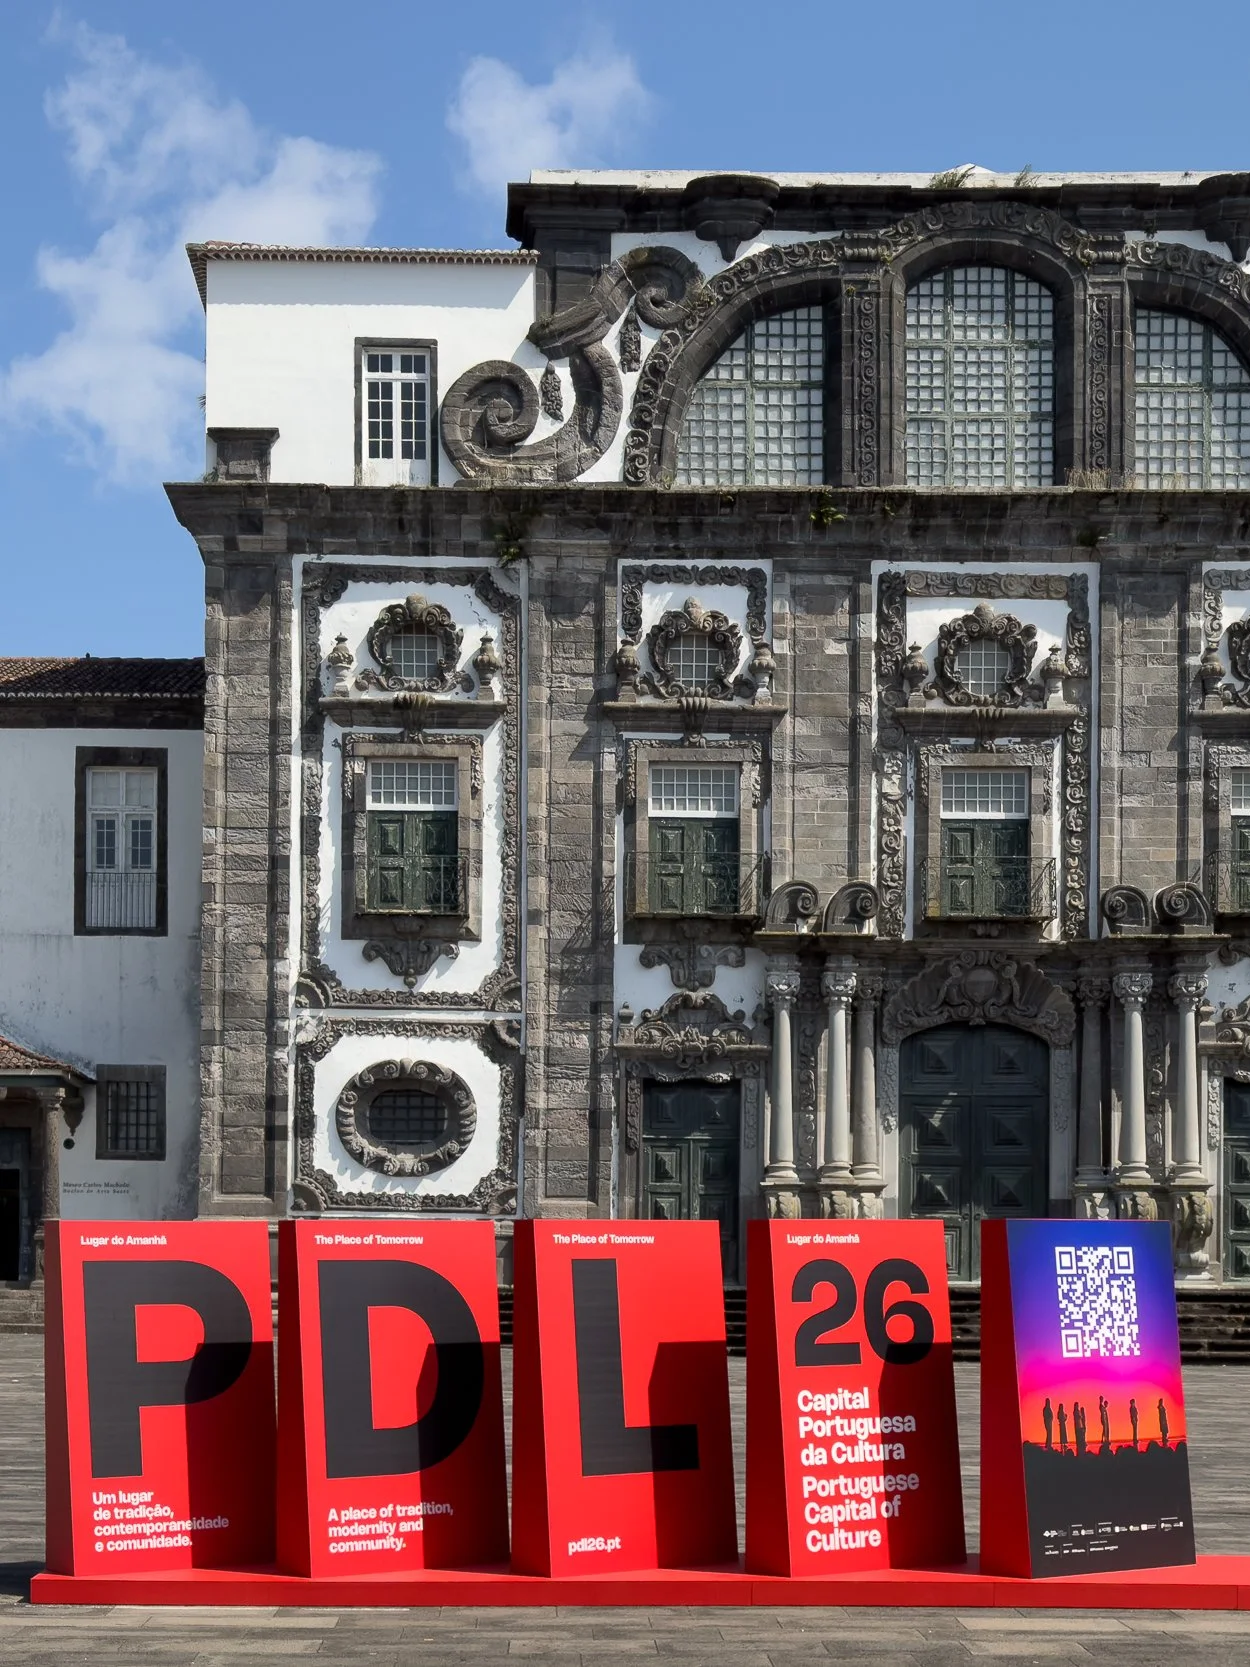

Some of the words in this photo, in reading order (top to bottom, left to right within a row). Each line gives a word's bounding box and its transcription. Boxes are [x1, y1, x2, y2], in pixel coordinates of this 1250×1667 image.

[80, 1235, 109, 1247] Lugar
[111, 1235, 124, 1245] do
[126, 1235, 167, 1245] Amanhã
[315, 1234, 333, 1245] The
[334, 1234, 362, 1245] Place
[363, 1234, 374, 1245] of
[375, 1234, 424, 1245] Tomorrow
[553, 1234, 570, 1244] The
[571, 1234, 597, 1244] Place
[598, 1234, 608, 1244] of
[609, 1234, 655, 1244] Tomorrow
[787, 1234, 812, 1246] Lugar
[813, 1234, 824, 1244] do
[825, 1234, 860, 1244] Amanhã
[791, 1258, 935, 1367] 26
[82, 1259, 253, 1479] P
[317, 1259, 485, 1479] D
[571, 1258, 700, 1477] L
[797, 1386, 870, 1416] Capital
[798, 1415, 917, 1440] Portuguesa
[801, 1443, 827, 1466] da
[831, 1440, 906, 1464] Cultura
[802, 1472, 920, 1499] Portuguese
[92, 1492, 117, 1505] Um
[118, 1490, 154, 1505] lugar
[93, 1507, 112, 1521] de
[113, 1504, 174, 1520] tradição,
[328, 1508, 339, 1521] A
[341, 1507, 378, 1523] place
[379, 1504, 394, 1518] of
[395, 1501, 454, 1517] tradition,
[804, 1497, 877, 1528] Capital
[880, 1494, 902, 1519] of
[94, 1516, 230, 1536] contemporaneidade
[328, 1520, 397, 1537] modernity
[398, 1518, 424, 1532] and
[95, 1541, 104, 1552] e
[106, 1533, 193, 1552] comunidade.
[329, 1535, 407, 1553] community.
[568, 1536, 621, 1556] pdl26.pt
[806, 1527, 882, 1553] Culture
